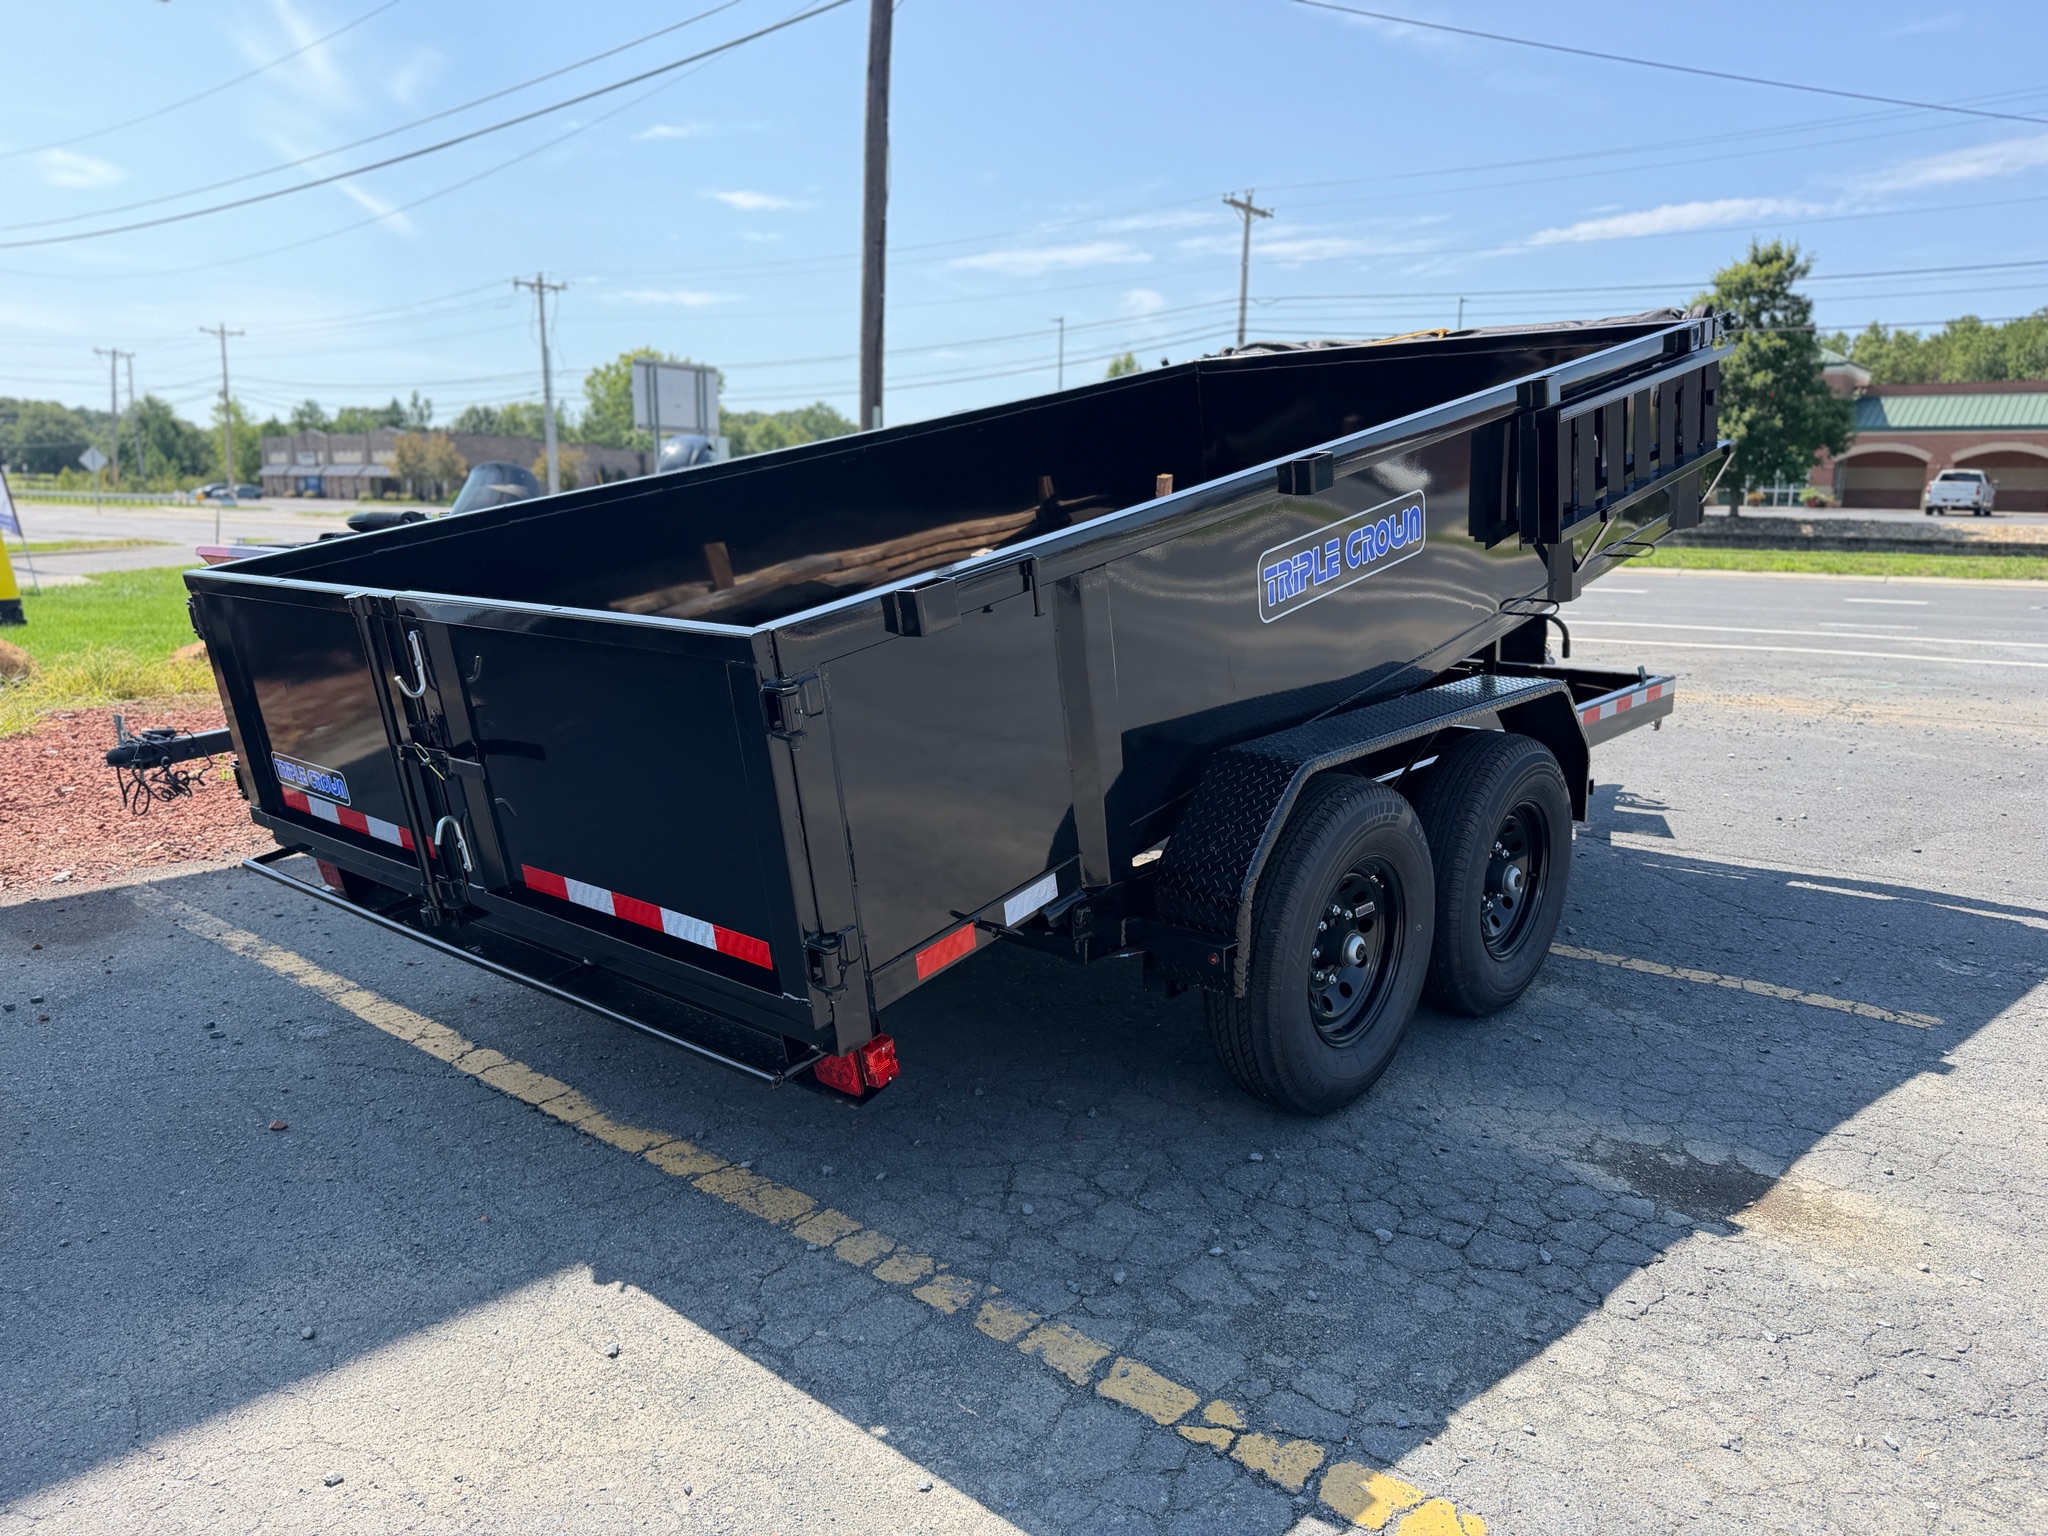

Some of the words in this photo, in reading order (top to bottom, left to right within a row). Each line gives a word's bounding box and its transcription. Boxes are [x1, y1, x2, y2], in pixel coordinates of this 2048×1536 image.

[1264, 538, 1340, 607] TRIPLE
[1346, 506, 1421, 569] CROWN
[274, 758, 309, 786] TRIPLE
[307, 769, 347, 799] CROWN
